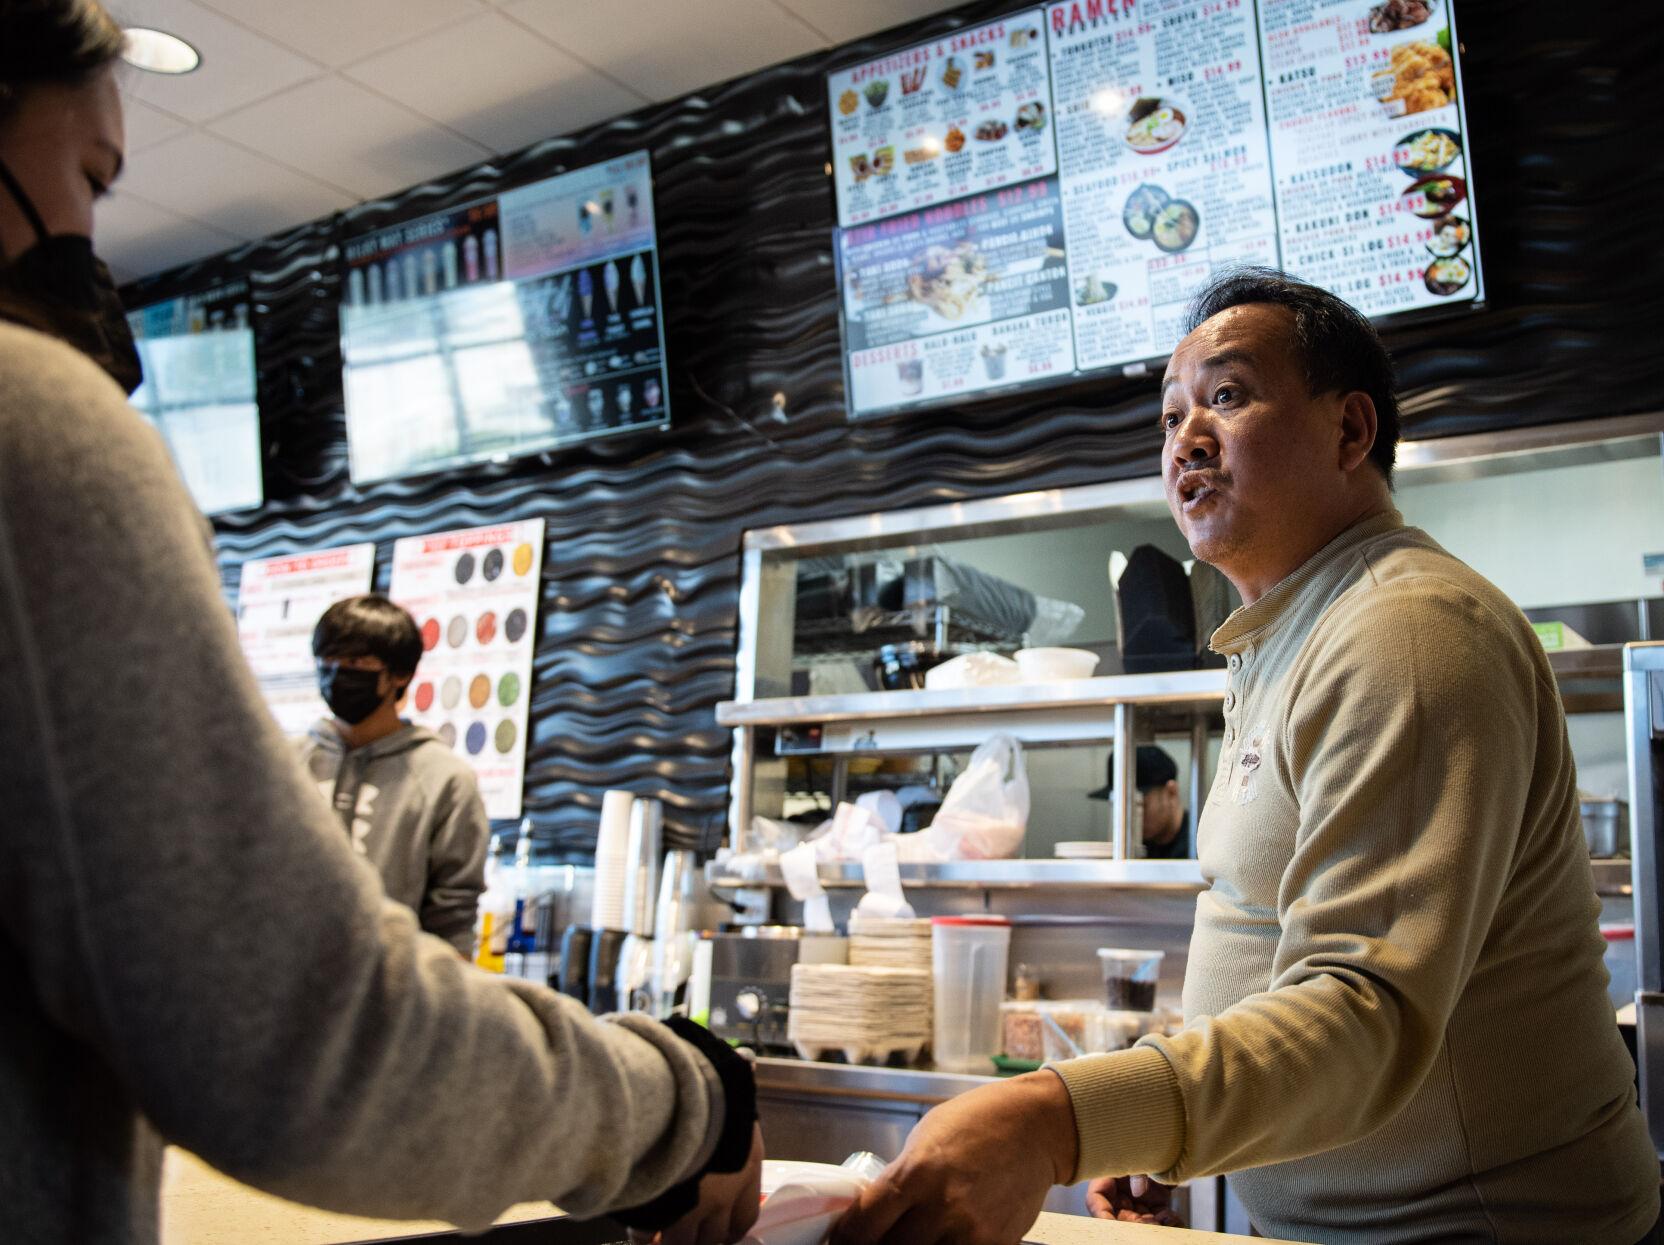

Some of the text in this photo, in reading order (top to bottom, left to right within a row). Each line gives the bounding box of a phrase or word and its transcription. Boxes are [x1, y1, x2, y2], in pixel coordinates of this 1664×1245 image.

[950, 22, 1005, 53] SNACKS
[1279, 65, 1315, 83] KATSU
[1289, 160, 1352, 183] KATSUDON
[1295, 215, 1340, 232] KAKUNI
[1345, 209, 1369, 222] DON
[1378, 268, 1424, 286] $14.99
